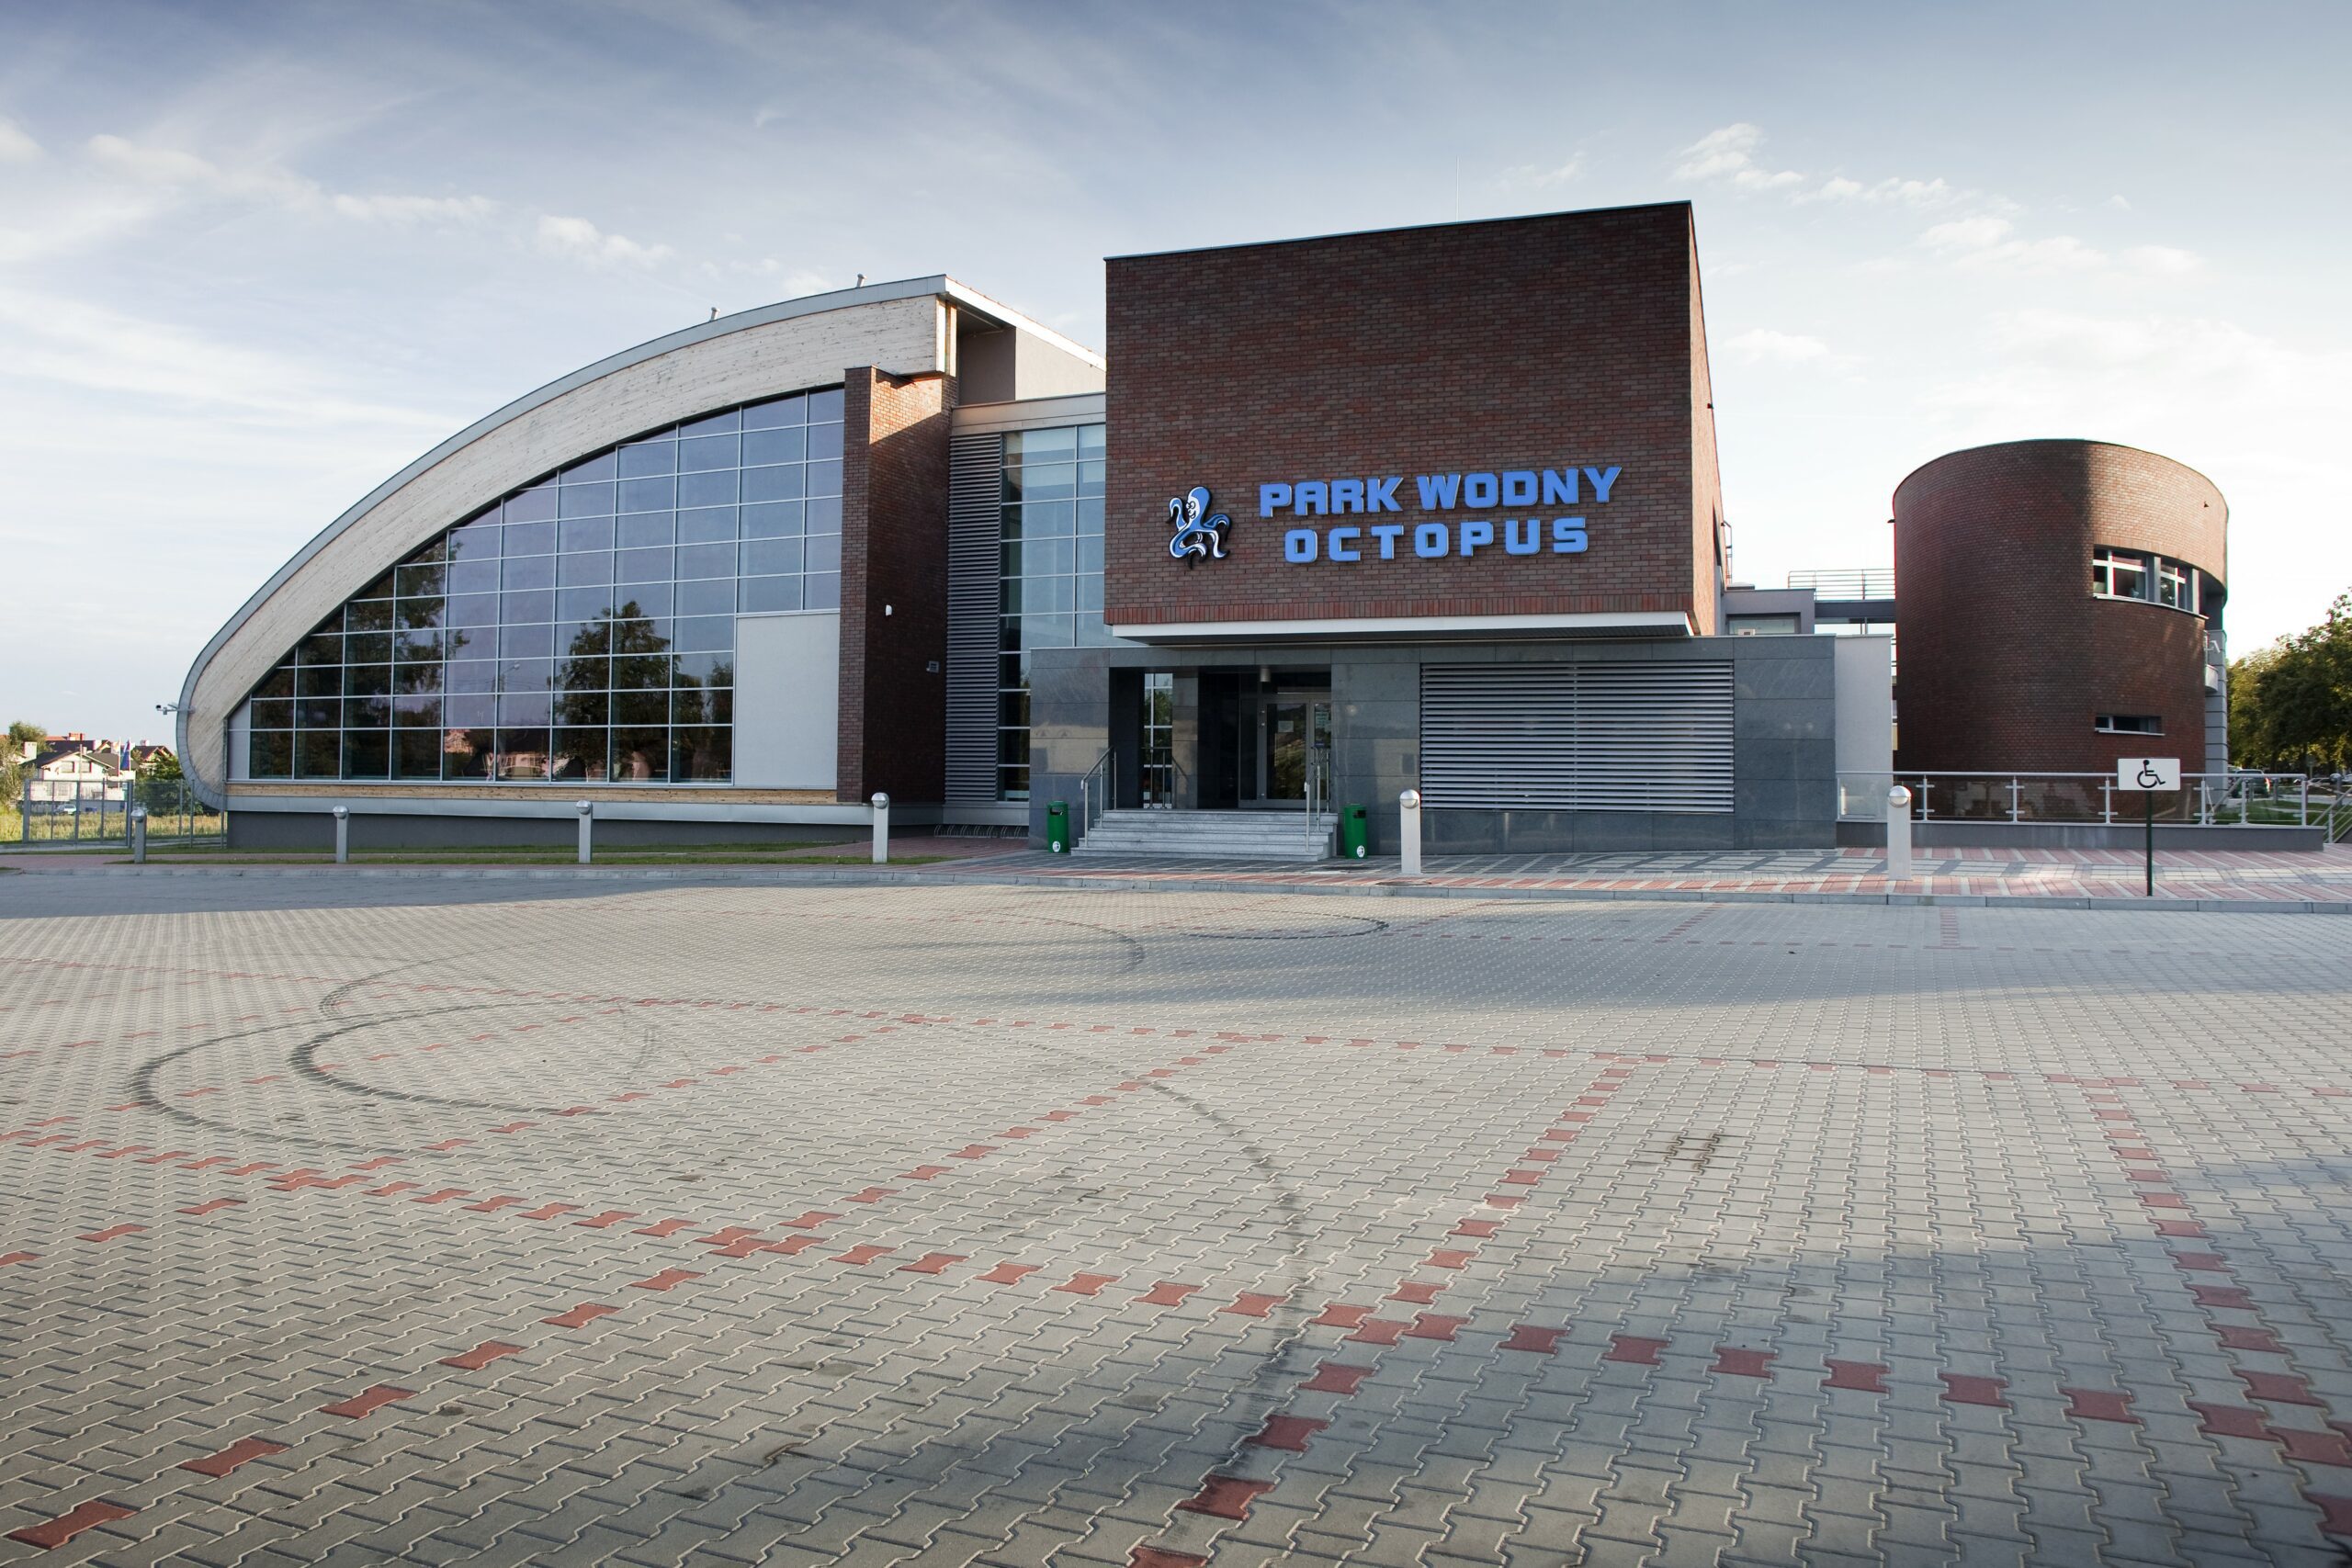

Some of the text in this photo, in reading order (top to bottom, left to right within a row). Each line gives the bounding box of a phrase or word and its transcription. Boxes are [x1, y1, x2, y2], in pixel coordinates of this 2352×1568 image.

[1259, 466, 1623, 518] PARK WODNY
[1283, 516, 1589, 563] OCTOPUS
